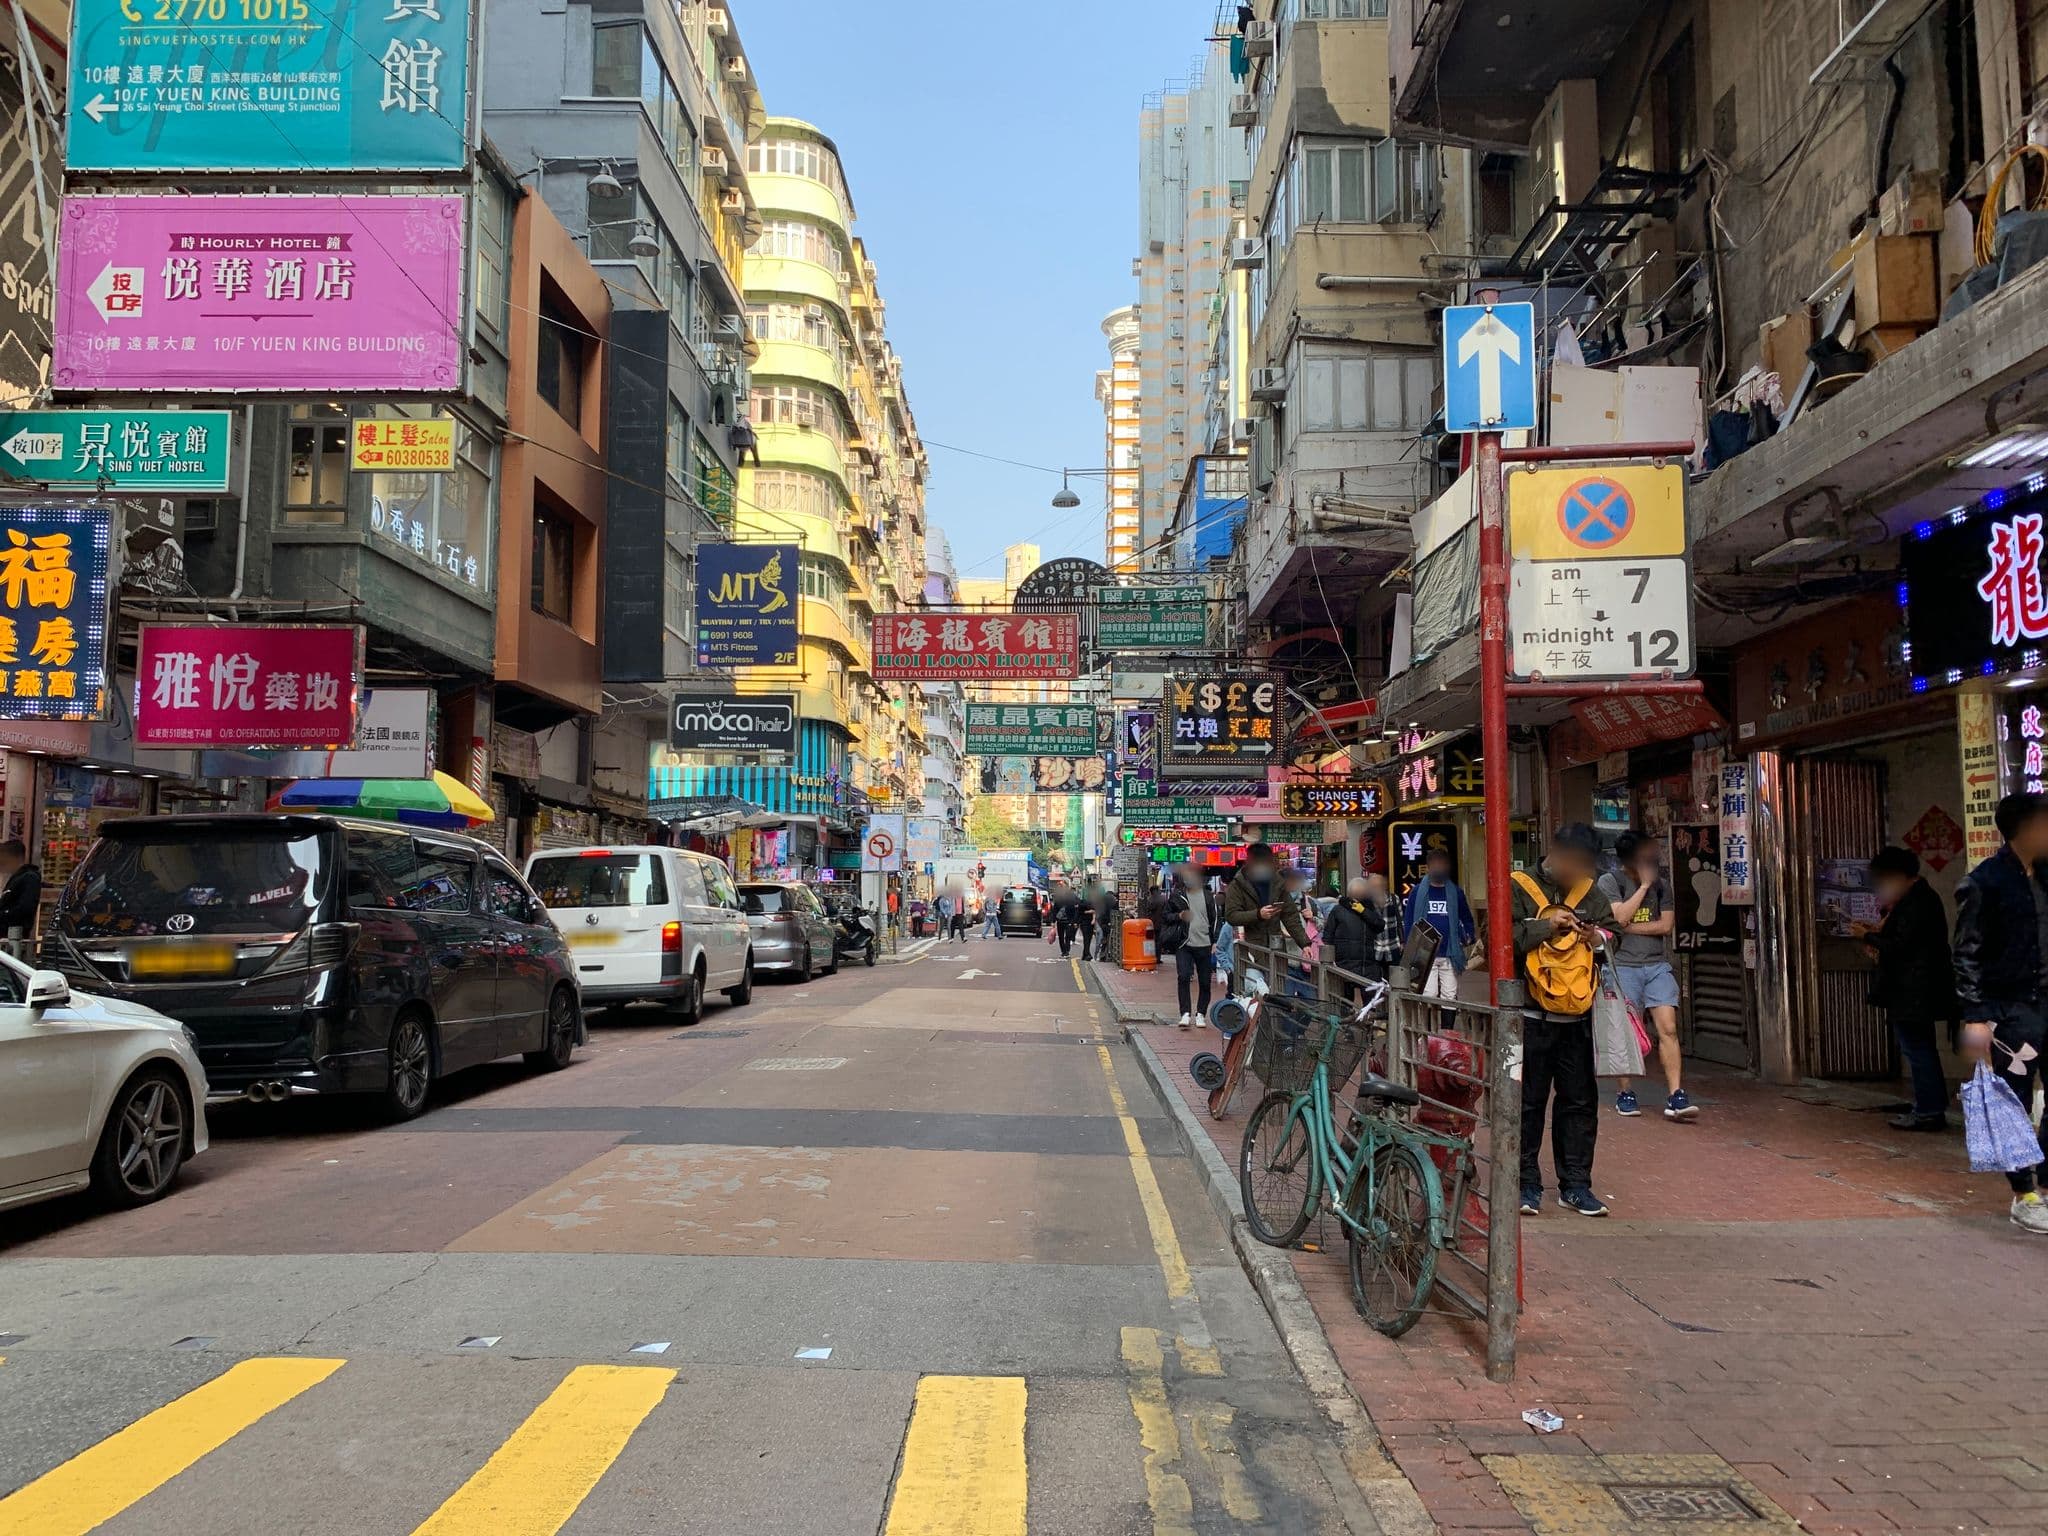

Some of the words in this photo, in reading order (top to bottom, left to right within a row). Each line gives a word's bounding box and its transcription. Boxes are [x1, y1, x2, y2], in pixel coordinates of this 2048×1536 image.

[114, 87, 149, 102] 10/F
[156, 87, 203, 101] YUEN
[211, 87, 250, 101] KING
[258, 87, 341, 101] BUILDING
[123, 103, 134, 112] 26
[137, 103, 151, 112] Sai
[154, 103, 182, 113] Yeung
[185, 103, 204, 112] Choi
[207, 103, 236, 112] Street
[238, 103, 285, 113] (Shantung
[288, 103, 298, 112] St
[299, 103, 341, 113] junction)
[270, 238, 321, 249] HOTEL
[112, 273, 132, 291] 按
[213, 337, 244, 351] 10/F
[251, 337, 297, 351] YUEN
[303, 337, 341, 351] KING
[347, 337, 426, 351] BUILDING
[357, 424, 419, 446] 樓上髮
[420, 430, 450, 445] Salon
[386, 450, 449, 465] 60380538
[108, 461, 132, 472] SING
[138, 461, 163, 472] YUET
[168, 461, 205, 472] HOSTEL
[0, 529, 77, 609] 福
[708, 549, 789, 613] MTS
[1551, 567, 1581, 580] am
[1623, 567, 1651, 604] 7
[1977, 513, 2048, 647] 龍
[1544, 587, 1591, 606] 上午
[1161, 612, 1203, 622] HOTEL
[710, 631, 730, 639] 6991
[897, 618, 1053, 653] 海龍賓館
[730, 643, 758, 651] Fitness
[1523, 626, 1615, 646] midnight
[1628, 629, 1679, 667] 12
[774, 652, 795, 664] 2/F
[876, 653, 921, 667] HOI
[926, 653, 989, 667] LOON
[995, 653, 1074, 667] HOTEL
[1546, 650, 1592, 670] 午夜
[876, 669, 906, 677] HOTEL
[960, 669, 984, 677] OVER
[985, 669, 1015, 677] NIGHT
[1016, 669, 1039, 677] LESS
[684, 713, 753, 731] moca
[755, 716, 785, 732] hair
[968, 707, 1094, 727] 麗晶賓館
[1042, 727, 1091, 736] HOTEL
[1307, 791, 1358, 800] CHANGE
[1134, 831, 1154, 839] FOOT
[1161, 831, 1182, 839] BODY
[1723, 834, 1749, 886] 音響
[1679, 932, 1708, 948] 2/F
